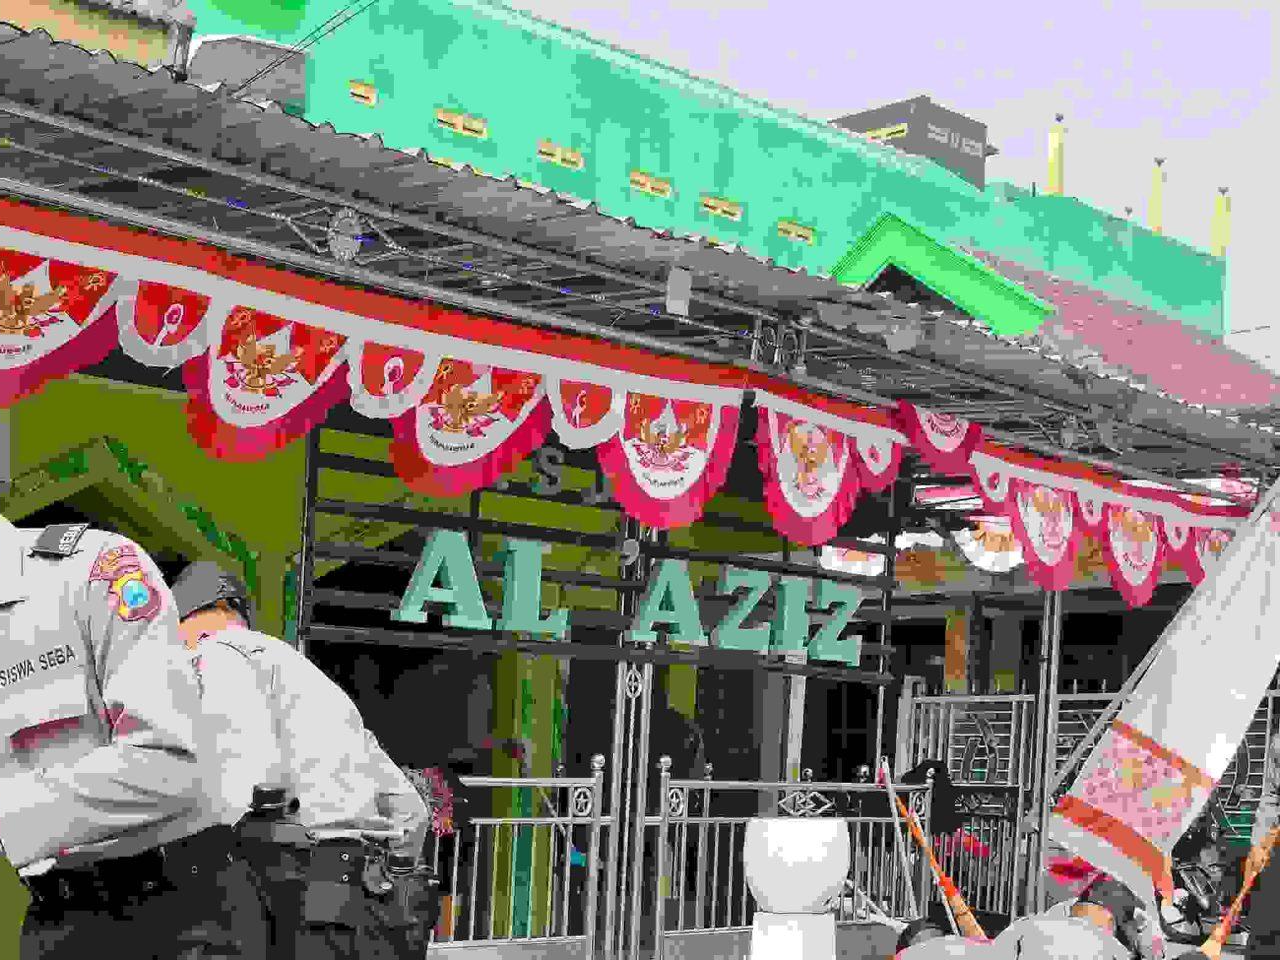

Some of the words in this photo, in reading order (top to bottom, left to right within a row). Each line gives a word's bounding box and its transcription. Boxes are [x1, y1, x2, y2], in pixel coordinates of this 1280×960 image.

[390, 527, 570, 642] AL
[631, 558, 864, 667] AZIZ
[0, 659, 36, 687] SISWA
[38, 644, 76, 671] SEBA
